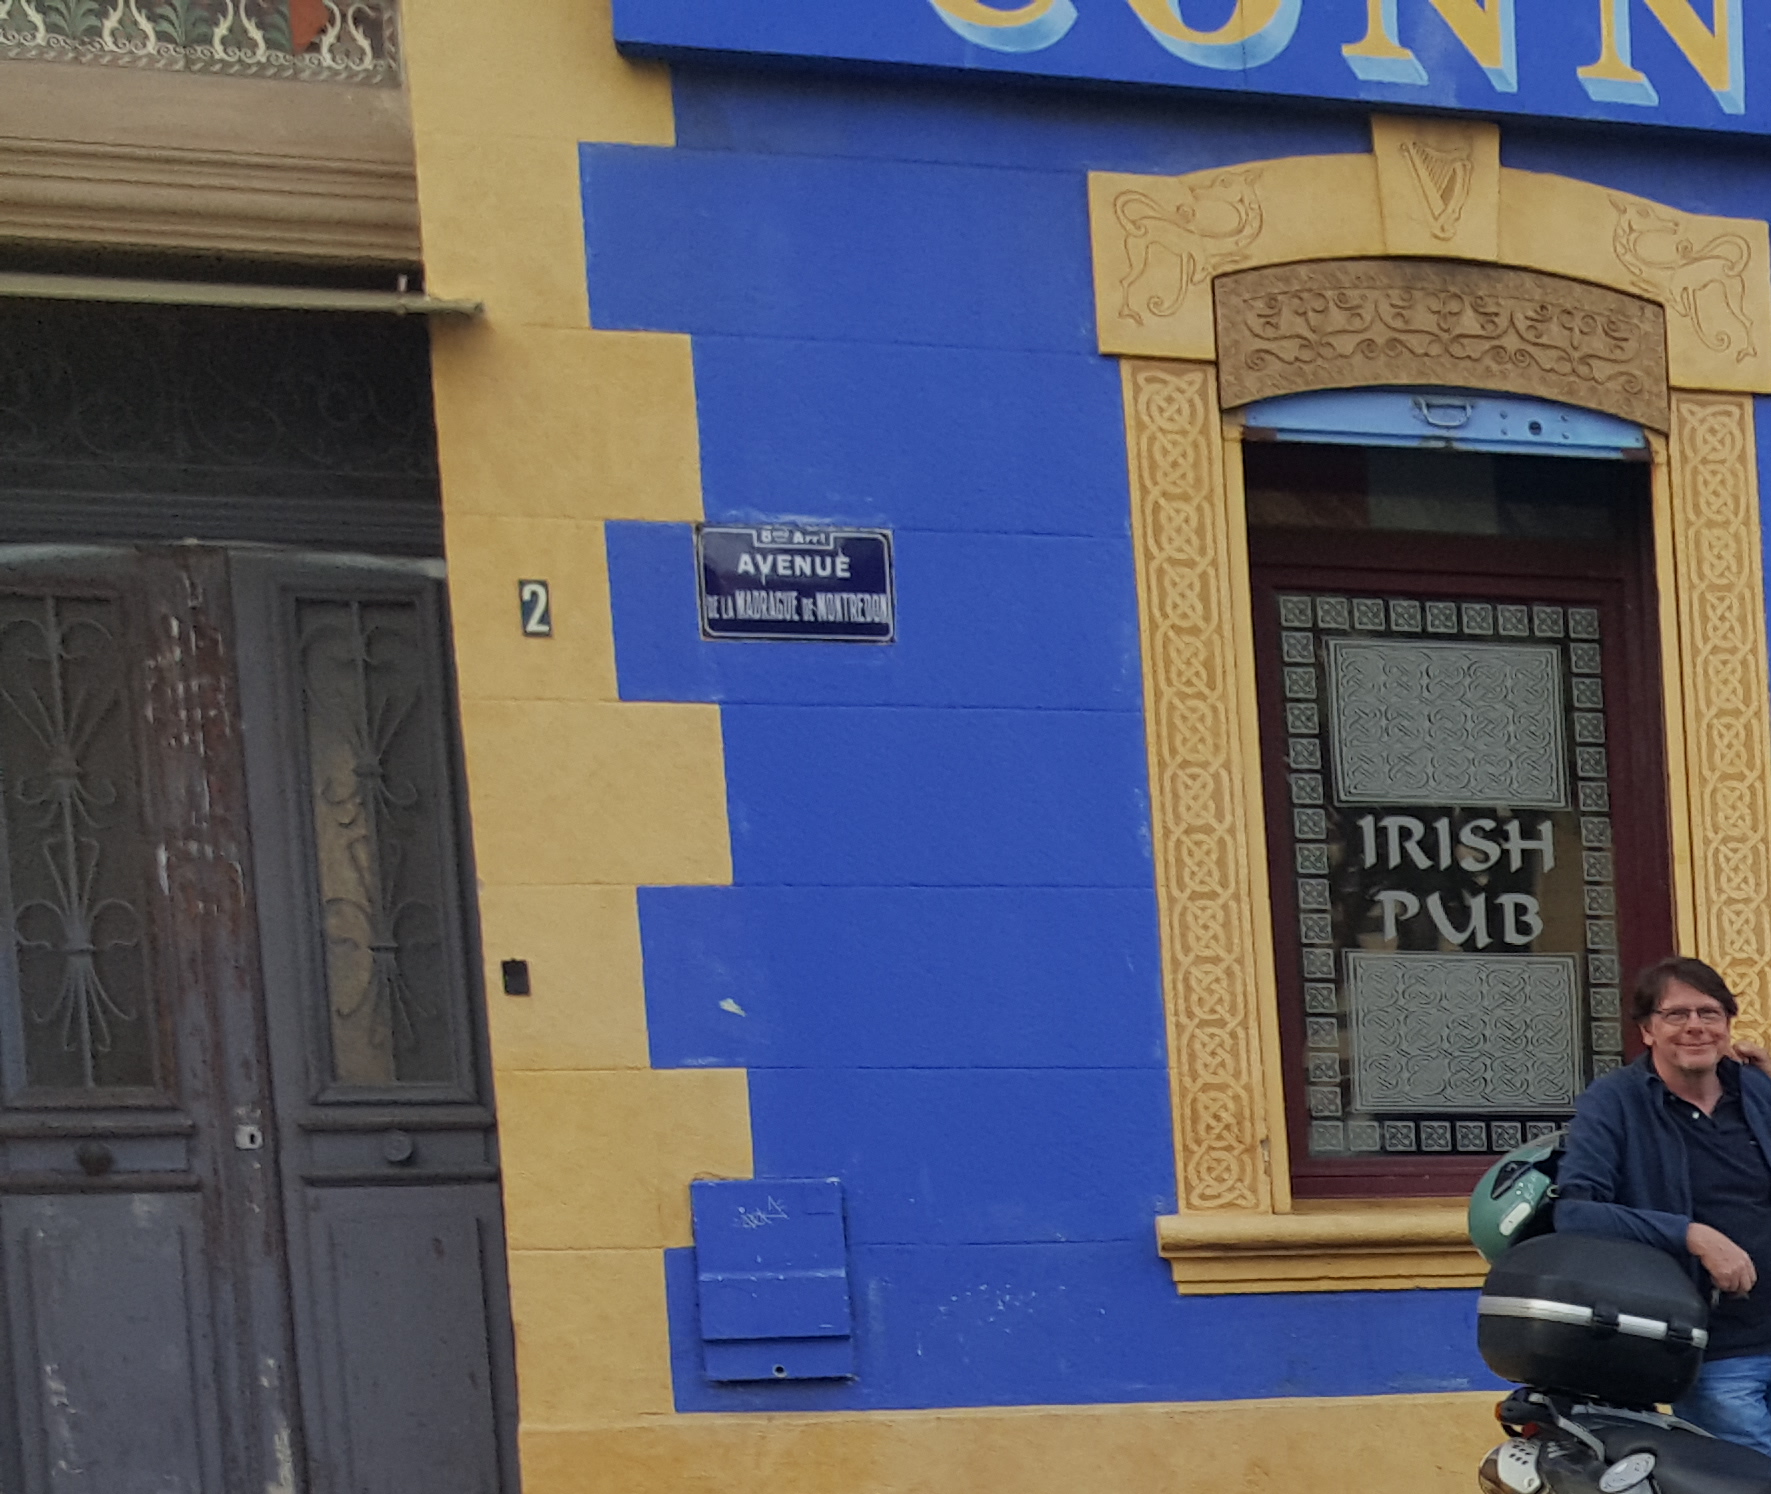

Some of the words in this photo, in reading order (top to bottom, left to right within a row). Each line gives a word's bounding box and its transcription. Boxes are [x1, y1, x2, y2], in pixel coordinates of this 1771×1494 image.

[737, 550, 852, 578] AVENUE
[522, 583, 550, 634] 2
[707, 595, 720, 618] DE
[722, 595, 735, 619] LA
[735, 589, 800, 621] MADRAGUE
[802, 597, 815, 621] DE
[815, 591, 889, 623] MONTREDON
[1357, 813, 1556, 874] IRISH
[1374, 889, 1544, 949] PUB
